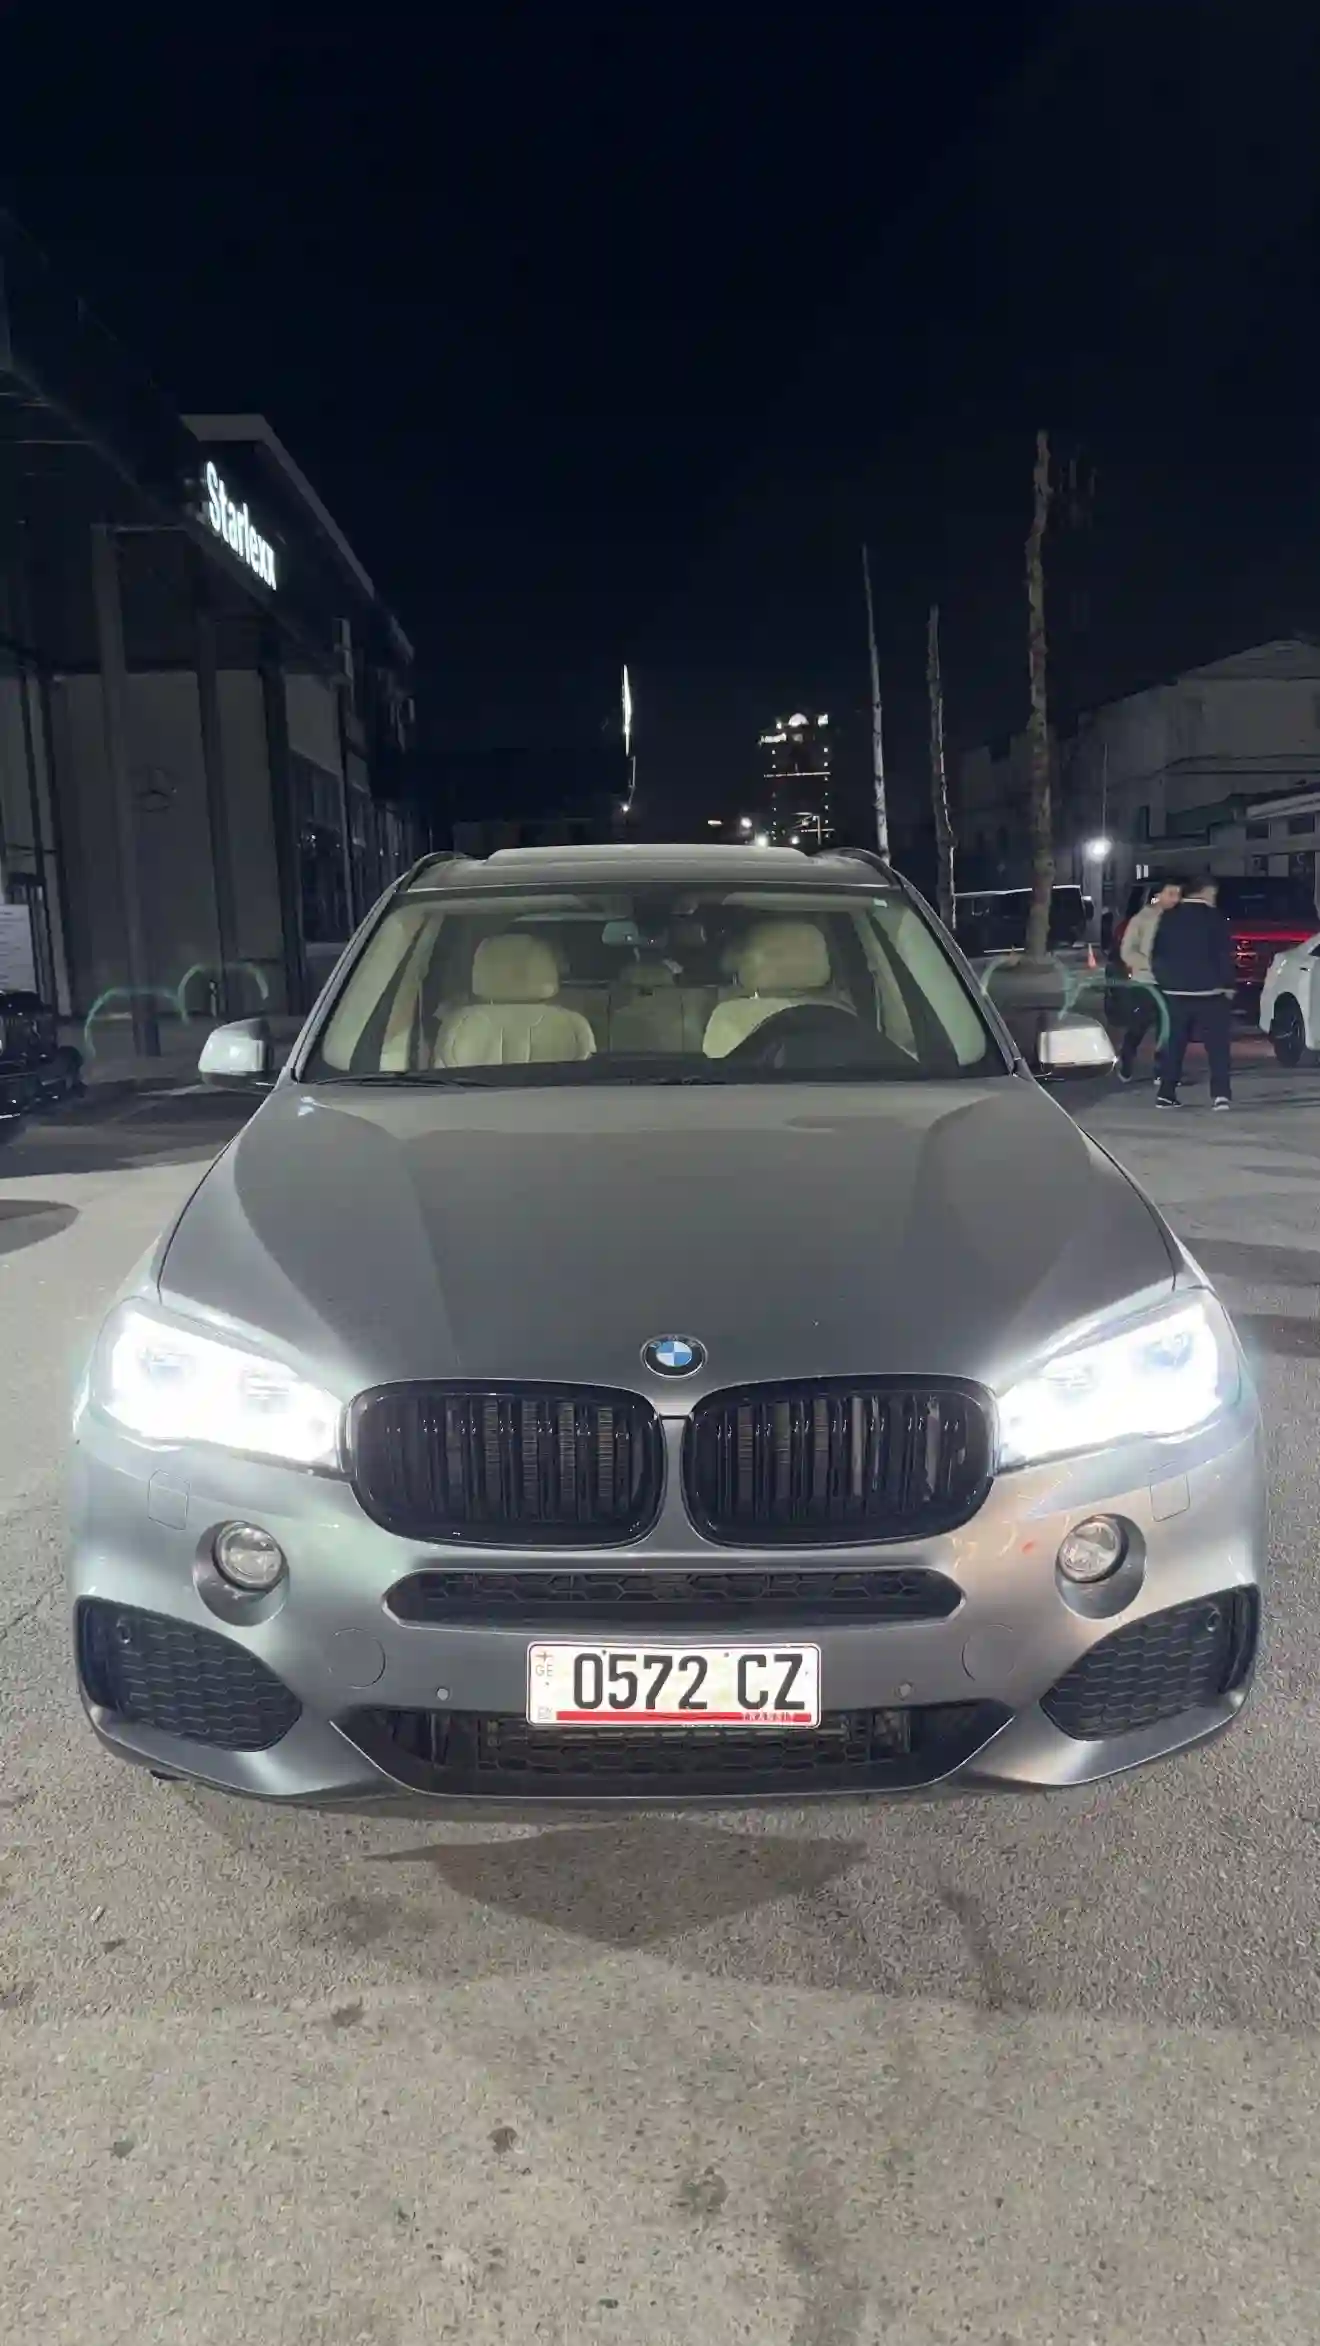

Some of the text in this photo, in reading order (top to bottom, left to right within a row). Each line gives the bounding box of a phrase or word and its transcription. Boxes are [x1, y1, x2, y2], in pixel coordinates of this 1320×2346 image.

[535, 1664, 553, 1677] GE
[573, 1652, 805, 1710] 0572 CZ
